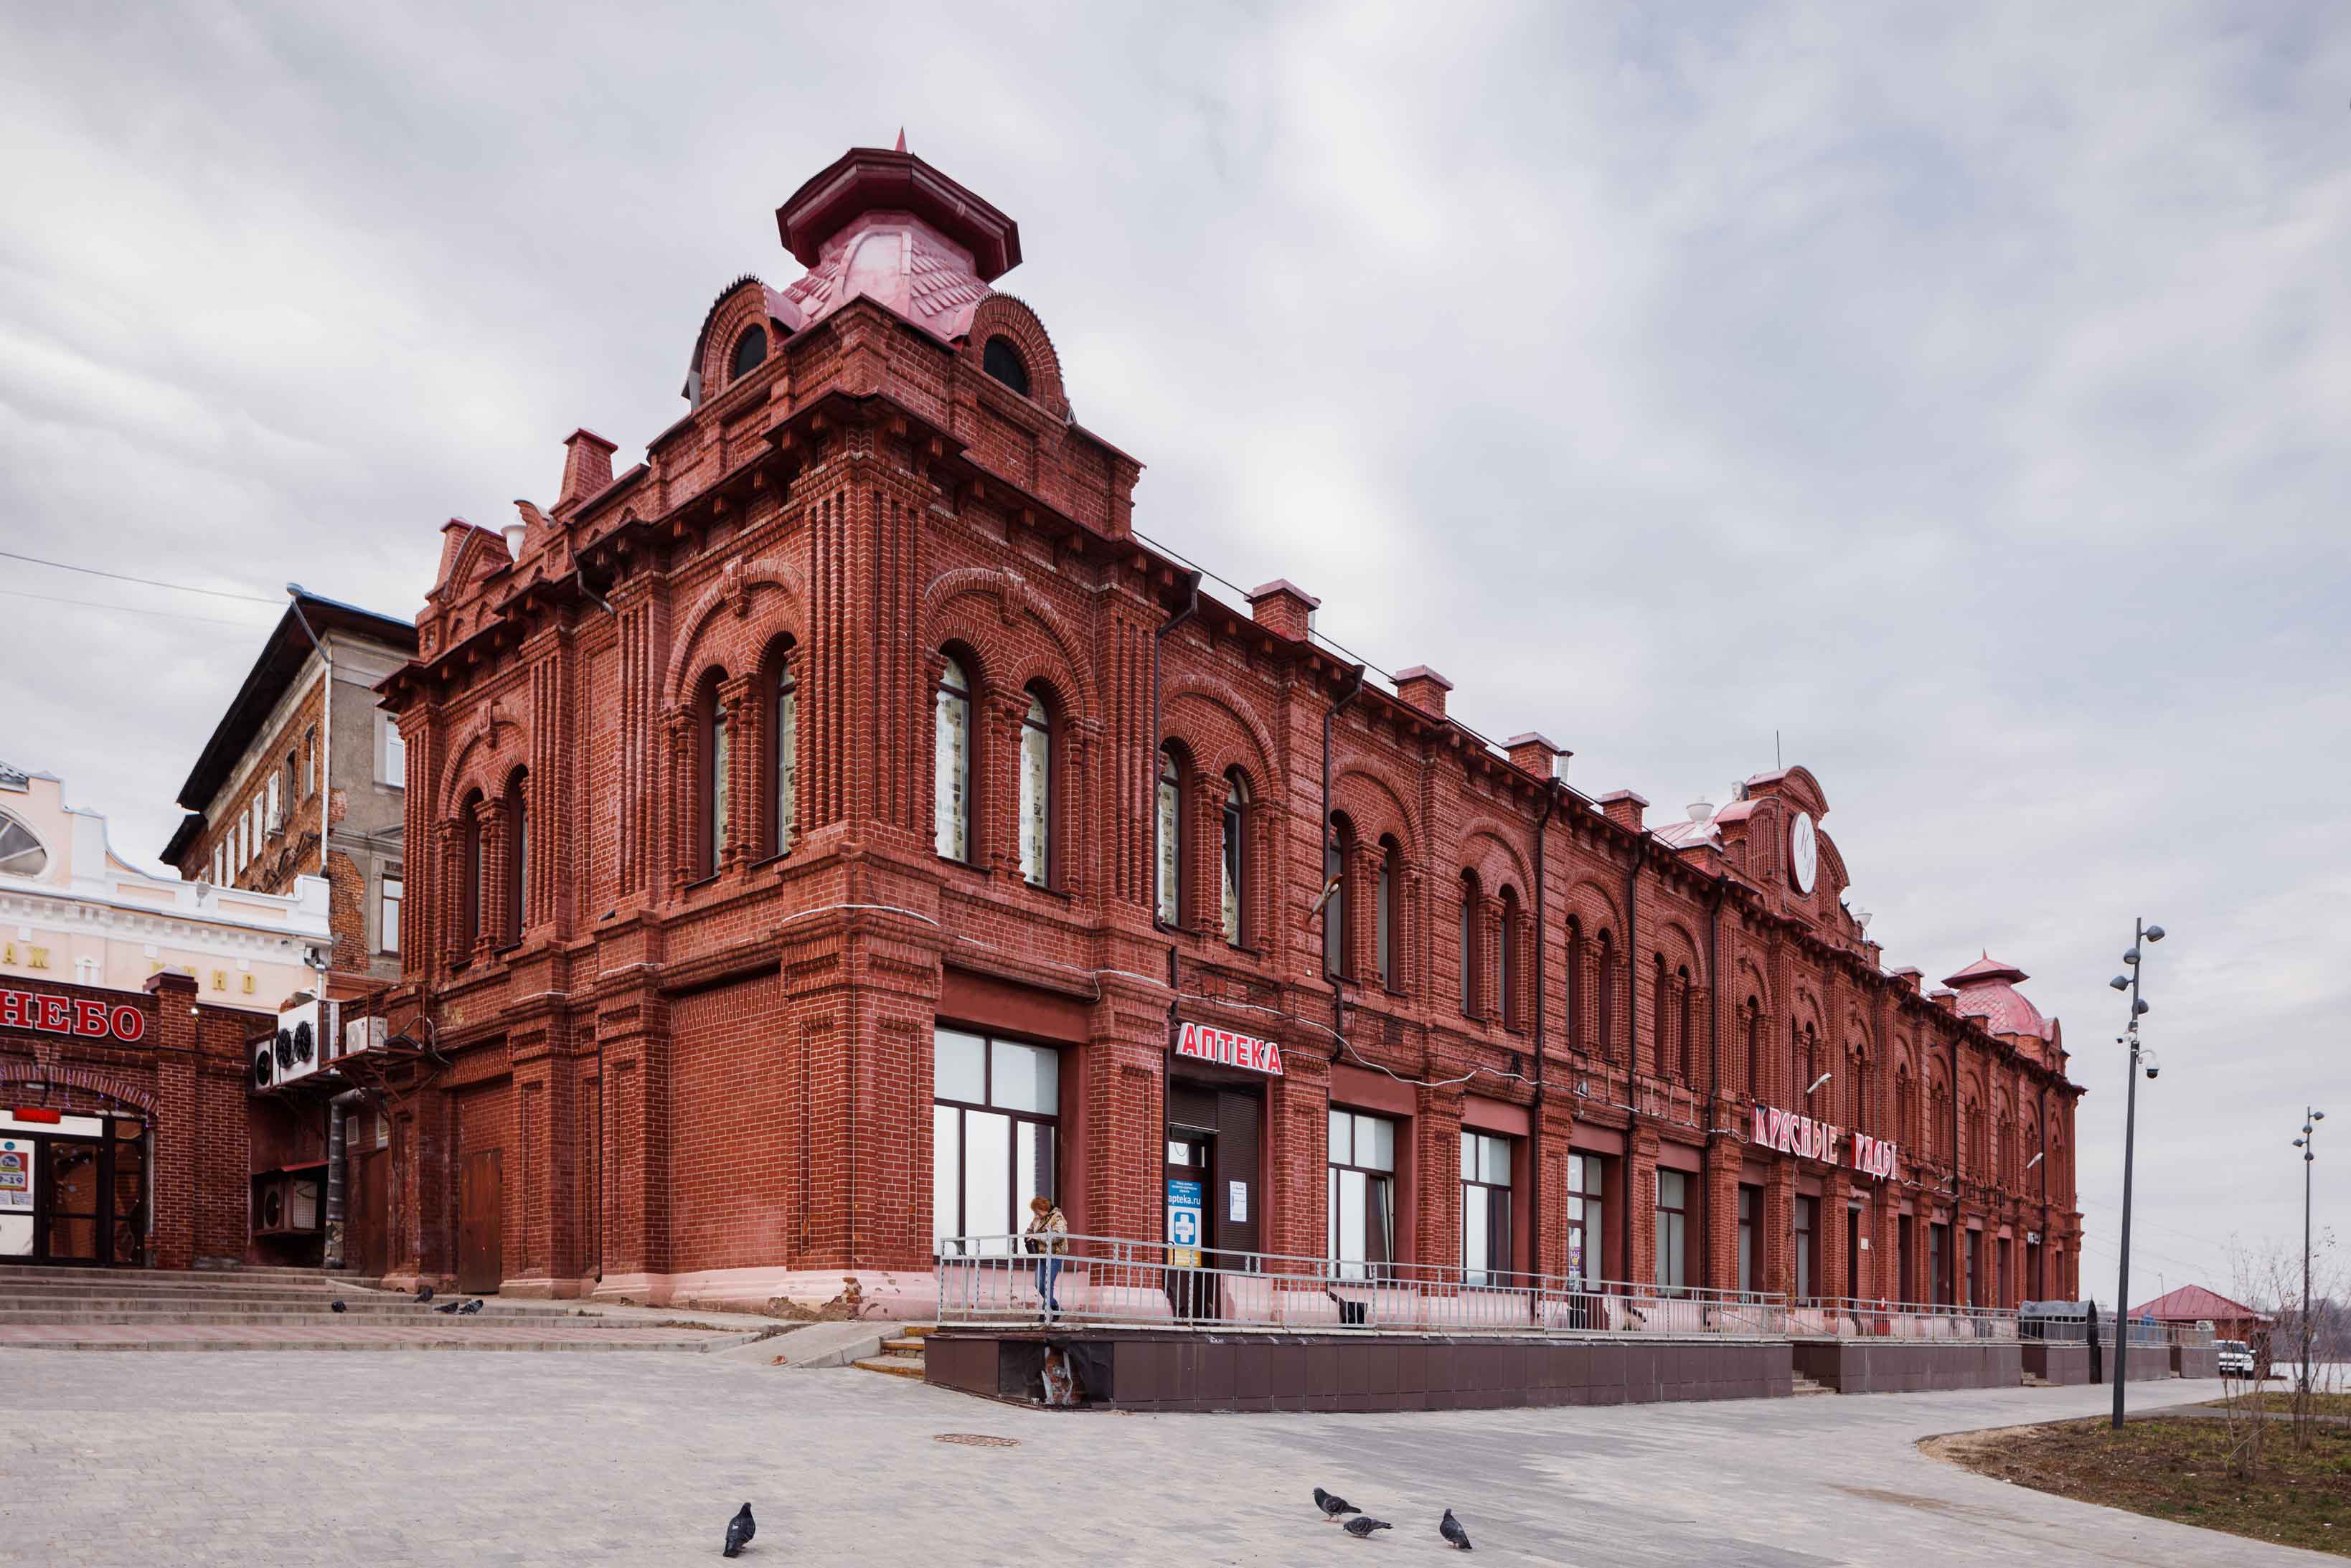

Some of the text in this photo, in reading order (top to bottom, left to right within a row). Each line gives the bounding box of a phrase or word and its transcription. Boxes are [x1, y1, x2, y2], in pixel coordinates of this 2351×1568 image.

[0, 988, 145, 1042] НЕБО
[1176, 1022, 1283, 1075] АПТЕКА
[1755, 1106, 1898, 1183] КРАСНЫЕ РЯДЫ
[1168, 1194, 1201, 1206] apteka.ru
